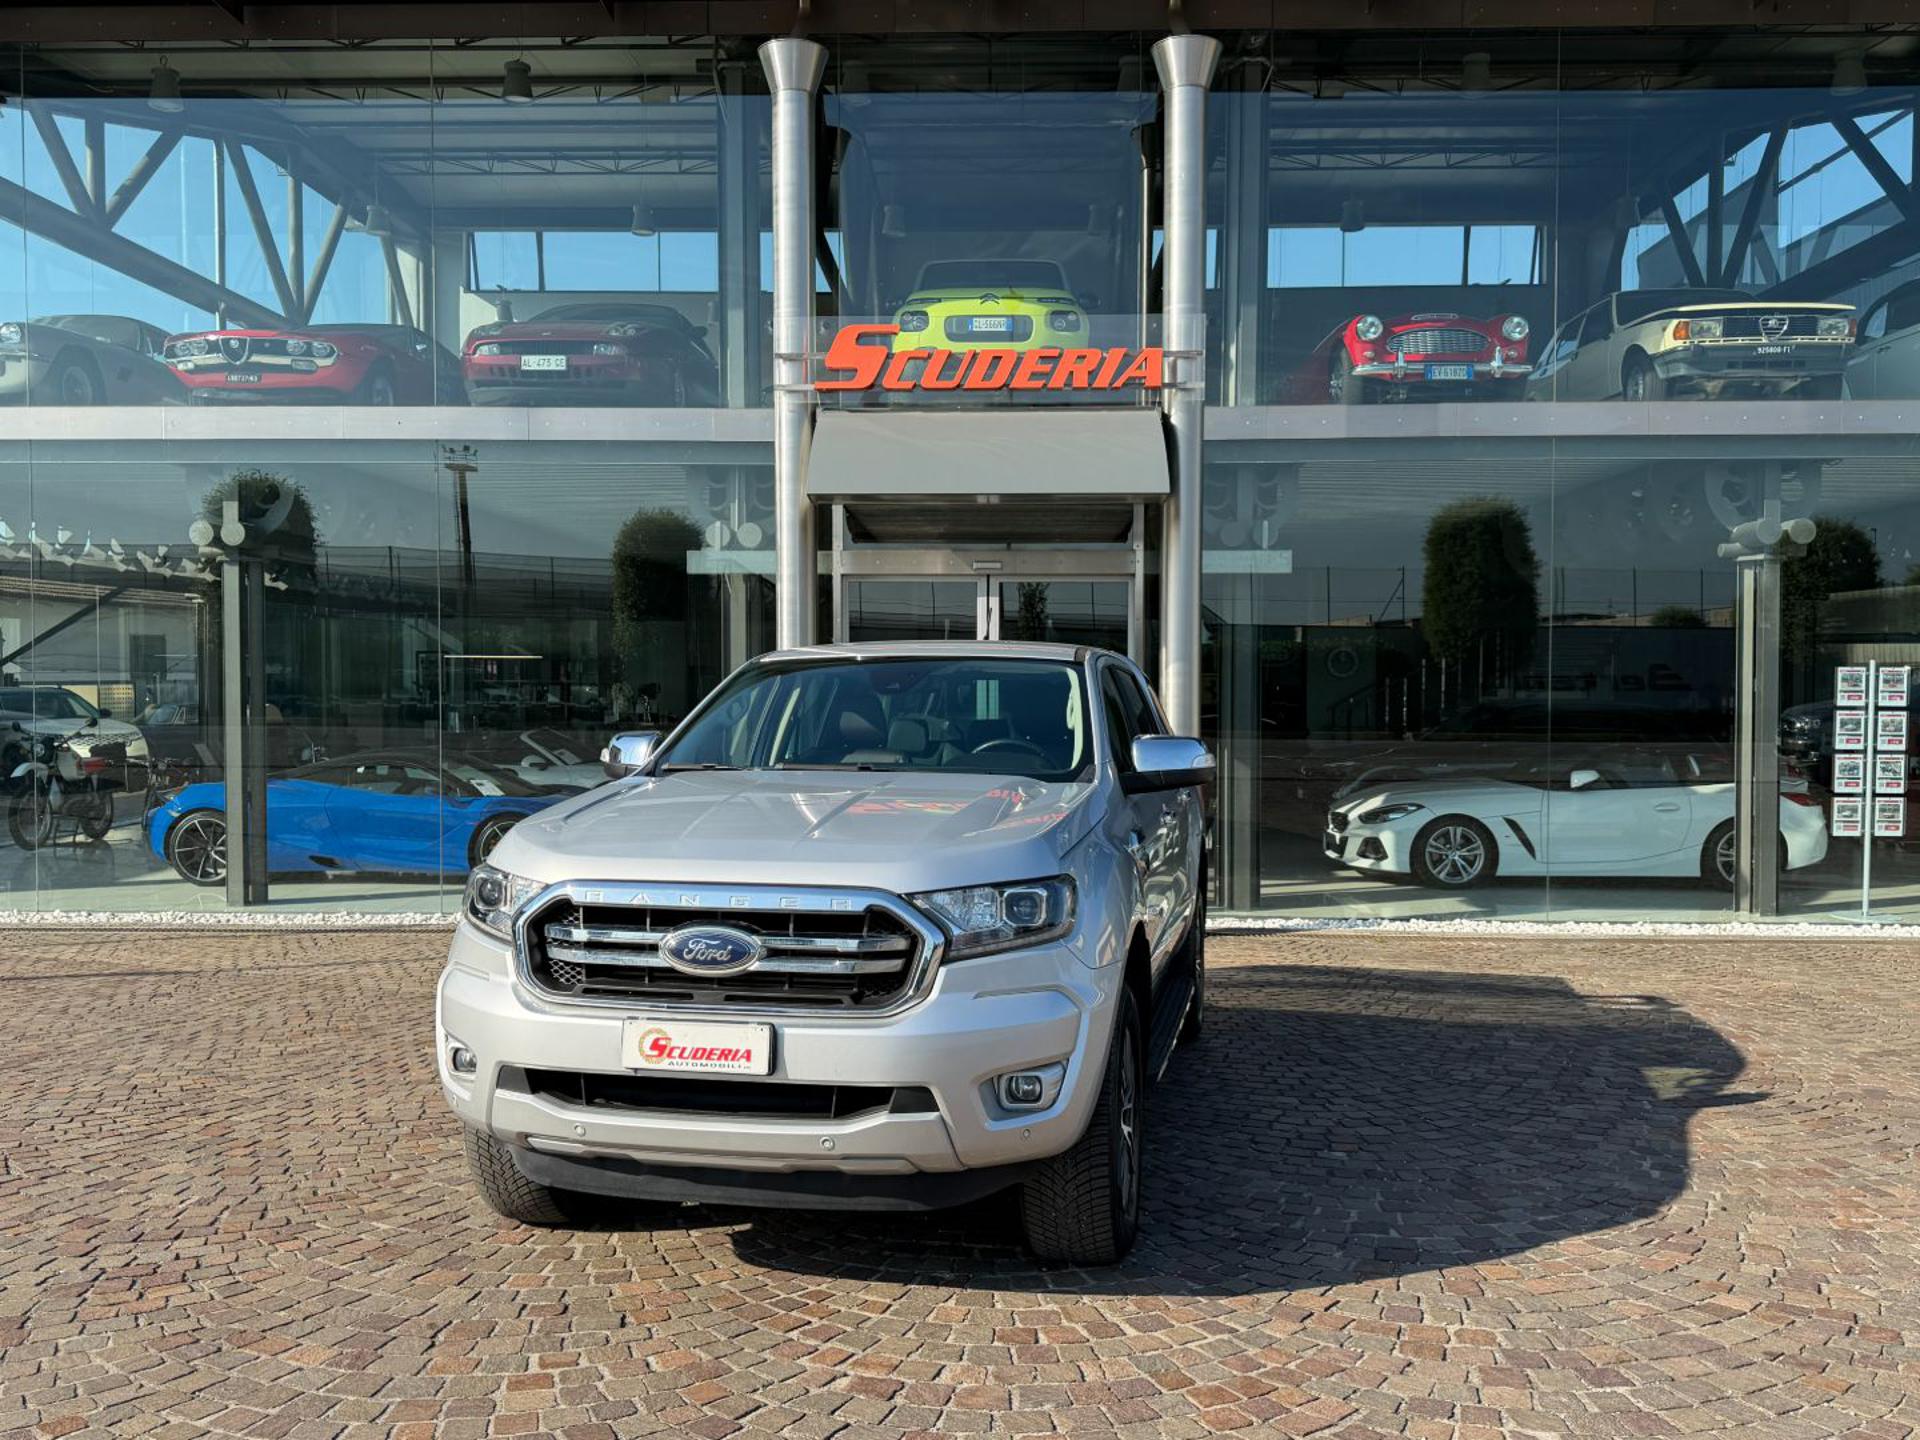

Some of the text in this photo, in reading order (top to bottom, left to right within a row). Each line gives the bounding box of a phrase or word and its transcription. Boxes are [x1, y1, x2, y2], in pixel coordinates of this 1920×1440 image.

[815, 324, 1163, 391] SCUDERIA
[585, 890, 851, 910] RANGER
[683, 938, 733, 961] Ford
[645, 1036, 752, 1062] SCUDERIA
